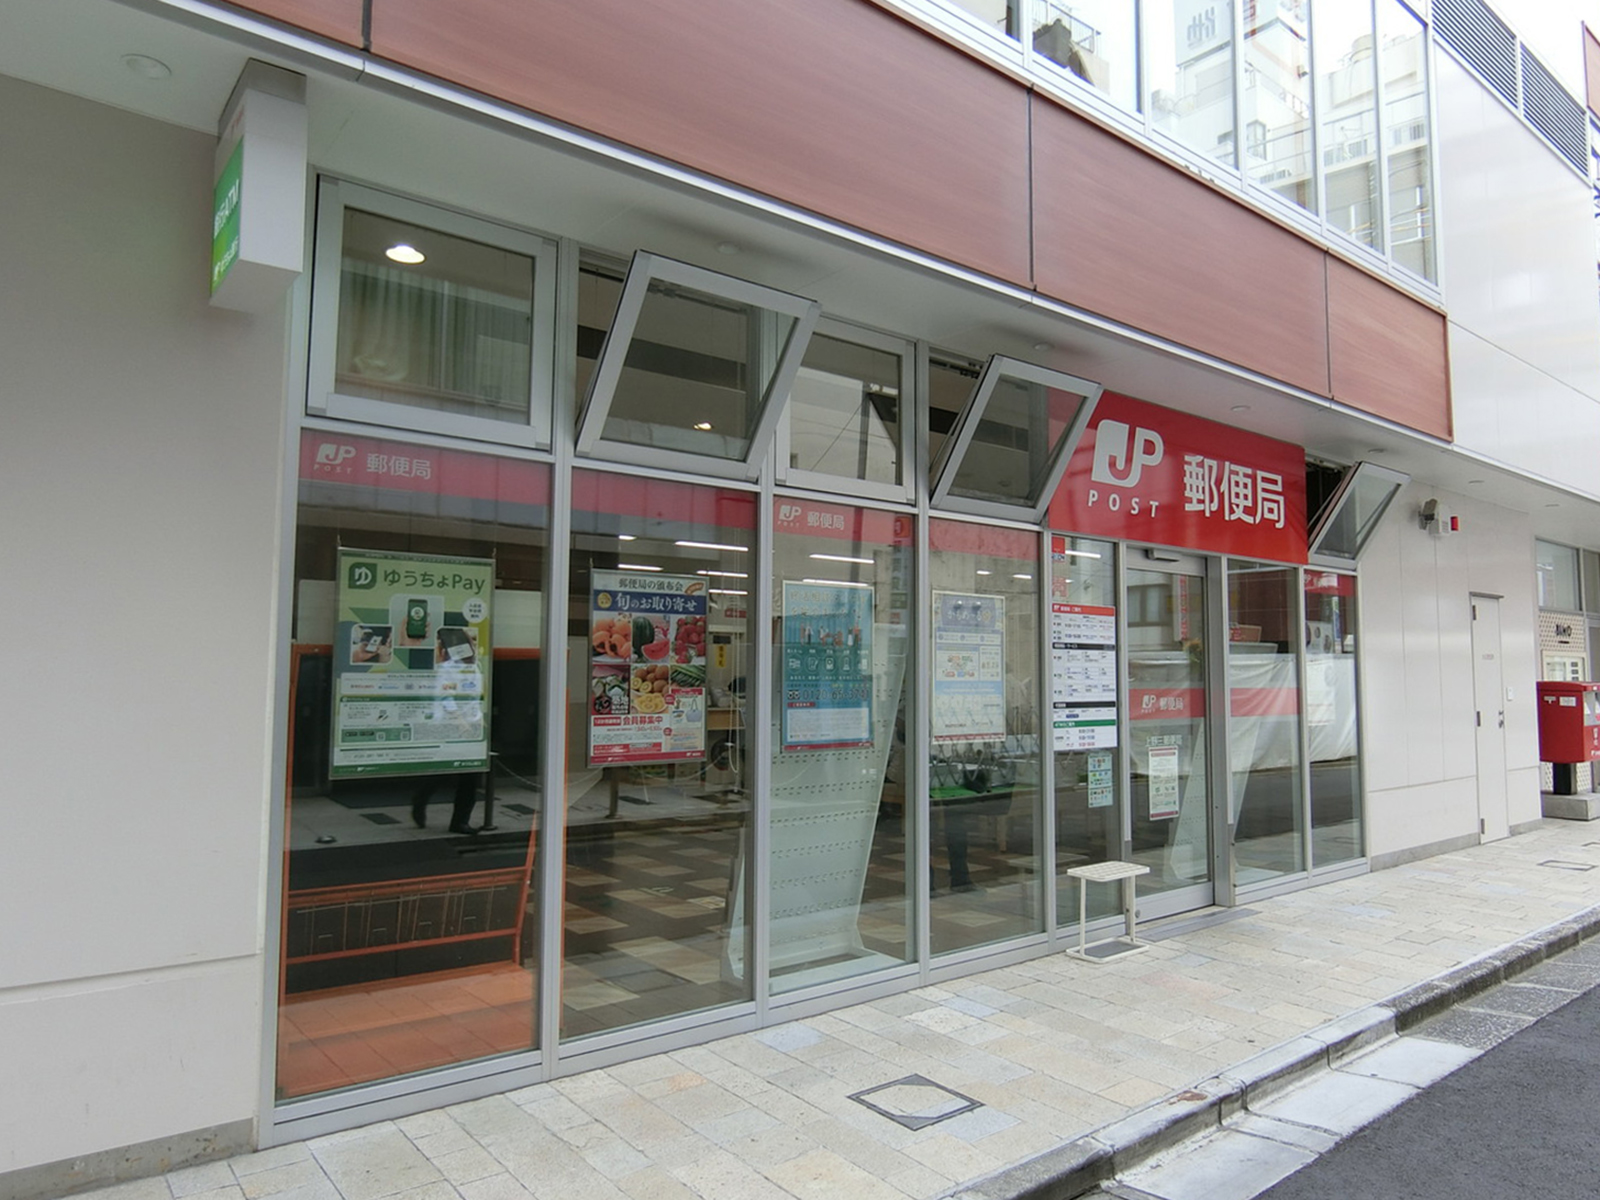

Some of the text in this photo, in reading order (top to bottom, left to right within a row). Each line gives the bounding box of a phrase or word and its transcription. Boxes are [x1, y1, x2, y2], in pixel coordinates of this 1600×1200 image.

[315, 443, 356, 465] JP
[1091, 419, 1164, 488] JP
[313, 464, 353, 475] POST
[366, 453, 432, 480] 郵便局
[1183, 455, 1285, 529] 郵便局
[779, 504, 801, 521] JP
[1087, 489, 1160, 518] POST
[807, 511, 845, 530] 郵便局
[383, 569, 486, 594] ゆうちょPay
[616, 592, 698, 612] 旬のお取り寄せ
[1159, 696, 1184, 711] 郵便局
